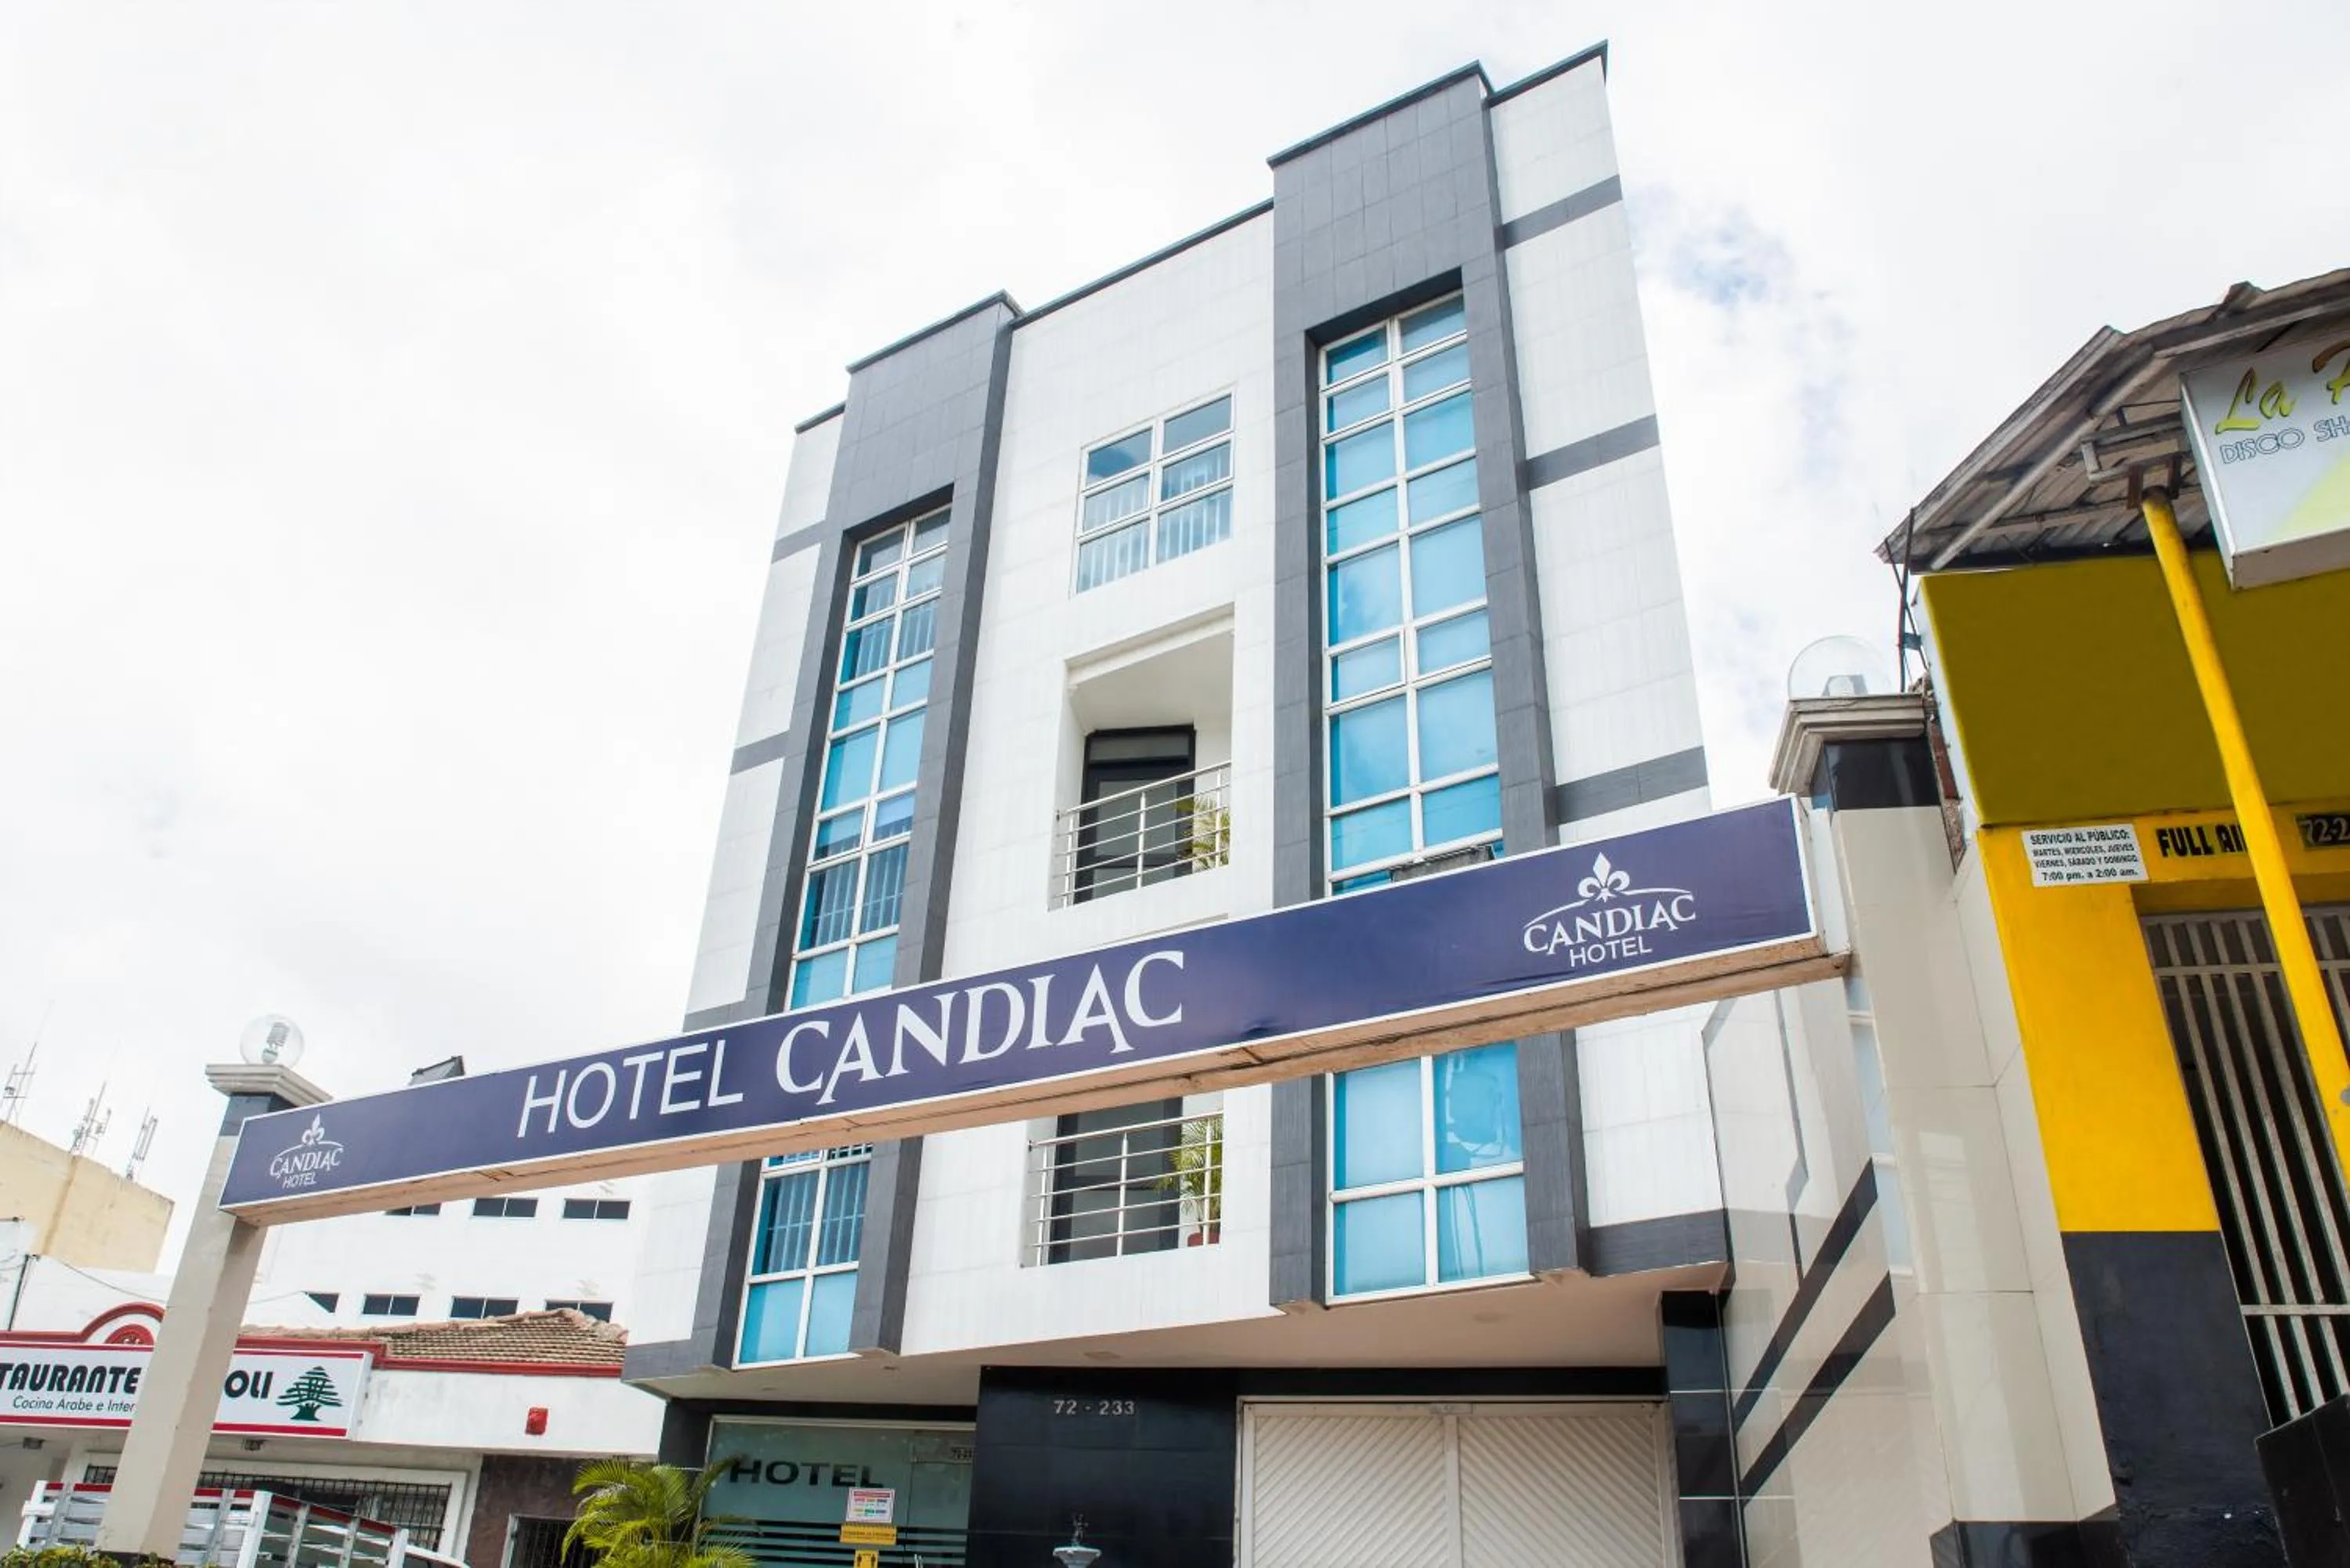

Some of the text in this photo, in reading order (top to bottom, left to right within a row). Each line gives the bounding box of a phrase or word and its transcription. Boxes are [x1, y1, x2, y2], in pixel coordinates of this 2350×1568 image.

[2214, 367, 2298, 435] La
[2220, 428, 2305, 464] DISCO
[2030, 832, 2072, 845] SERVICIO
[2075, 832, 2086, 843] AL
[2156, 826, 2214, 858] FULL
[2041, 871, 2064, 881] 7:00
[2066, 872, 2084, 882] pm.
[2095, 868, 2117, 878] 2:00
[2119, 868, 2138, 876] am.
[1524, 894, 1696, 956] CANDIAC
[1569, 936, 1653, 967] HOTEL
[517, 950, 1184, 1138] HOTEL CANDIAC
[269, 1147, 344, 1180] CANDIAC
[283, 1172, 317, 1188] HOTEL
[13, 1395, 54, 1410] Cocina
[56, 1397, 93, 1411] Arabe
[96, 1401, 104, 1411] e
[1053, 1399, 1078, 1415] 72
[1098, 1399, 1136, 1415] 233
[729, 1458, 884, 1488] HOTEL
